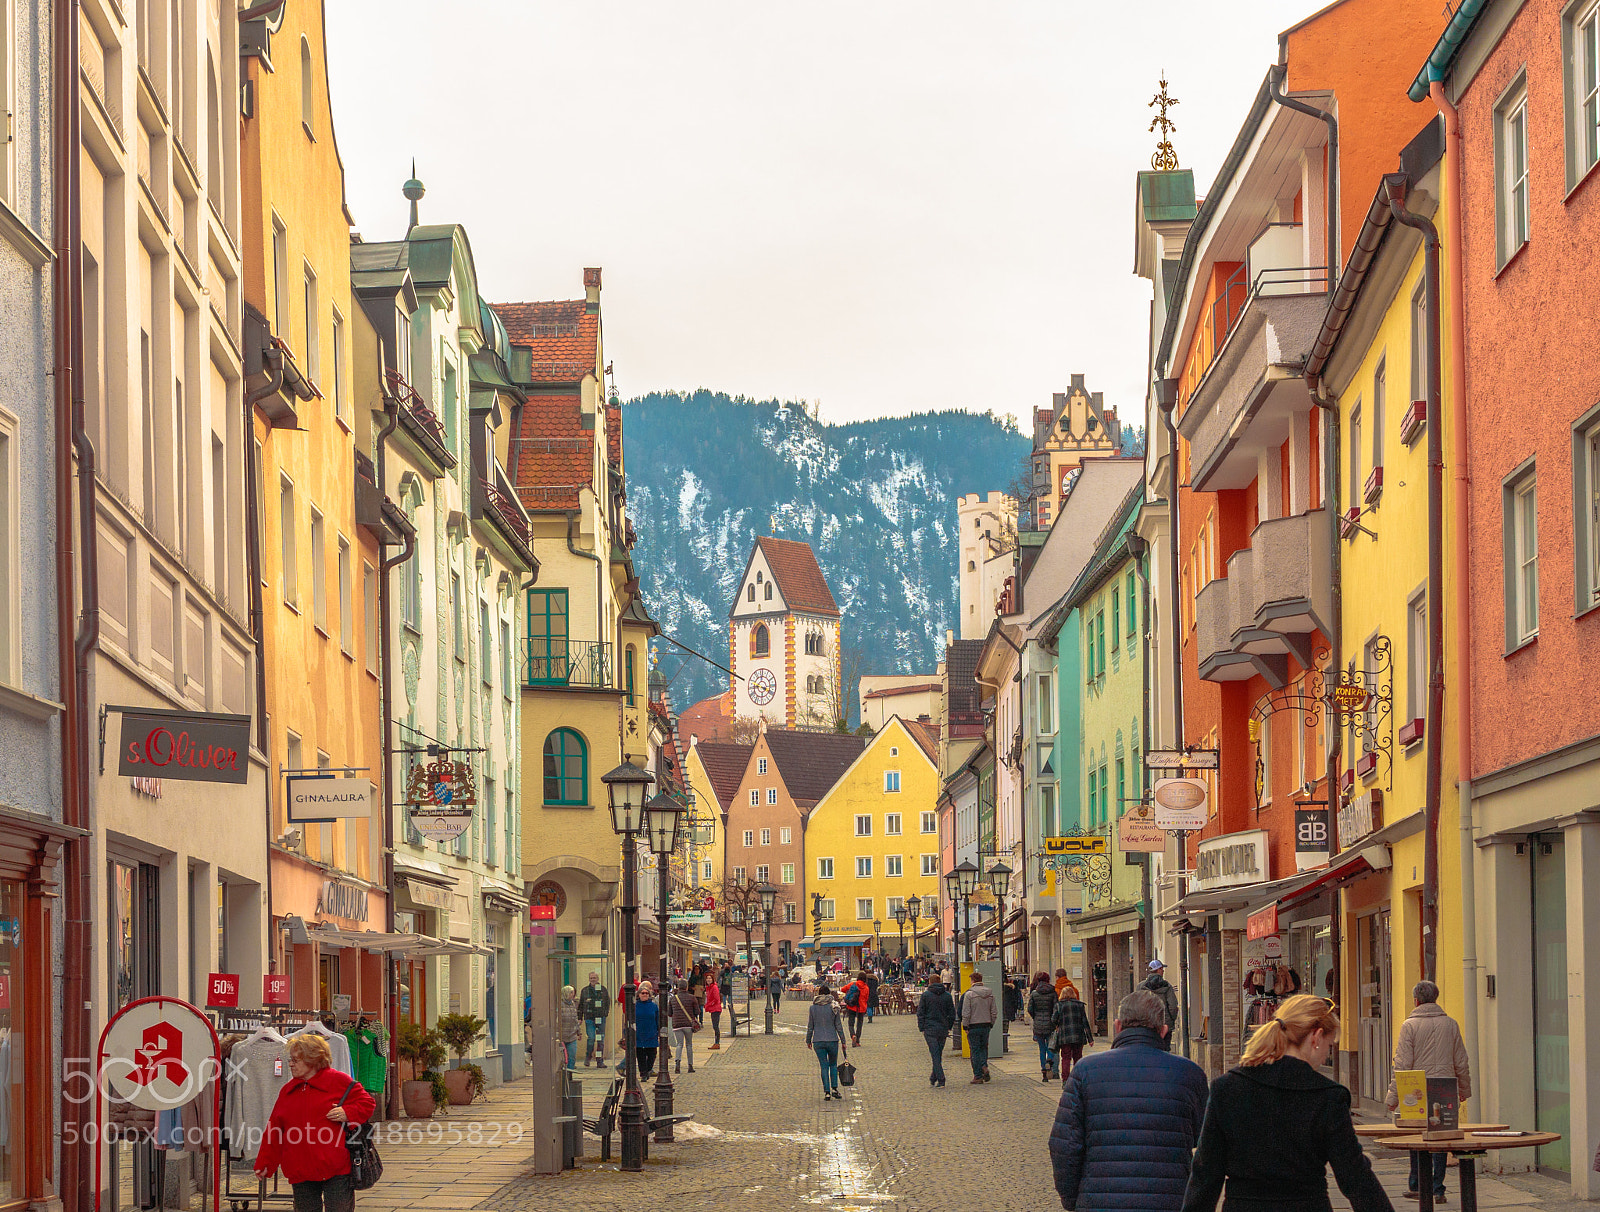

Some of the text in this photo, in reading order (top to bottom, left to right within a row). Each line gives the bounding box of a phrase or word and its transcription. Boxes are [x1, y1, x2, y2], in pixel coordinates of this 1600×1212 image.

[1335, 687, 1368, 697] KONRAD
[1334, 695, 1360, 706] METZ
[126, 726, 241, 771] s.Oliver
[295, 793, 365, 803] GINALAURA
[1121, 833, 1163, 843] Asia Garten
[1047, 840, 1104, 851] WOLF
